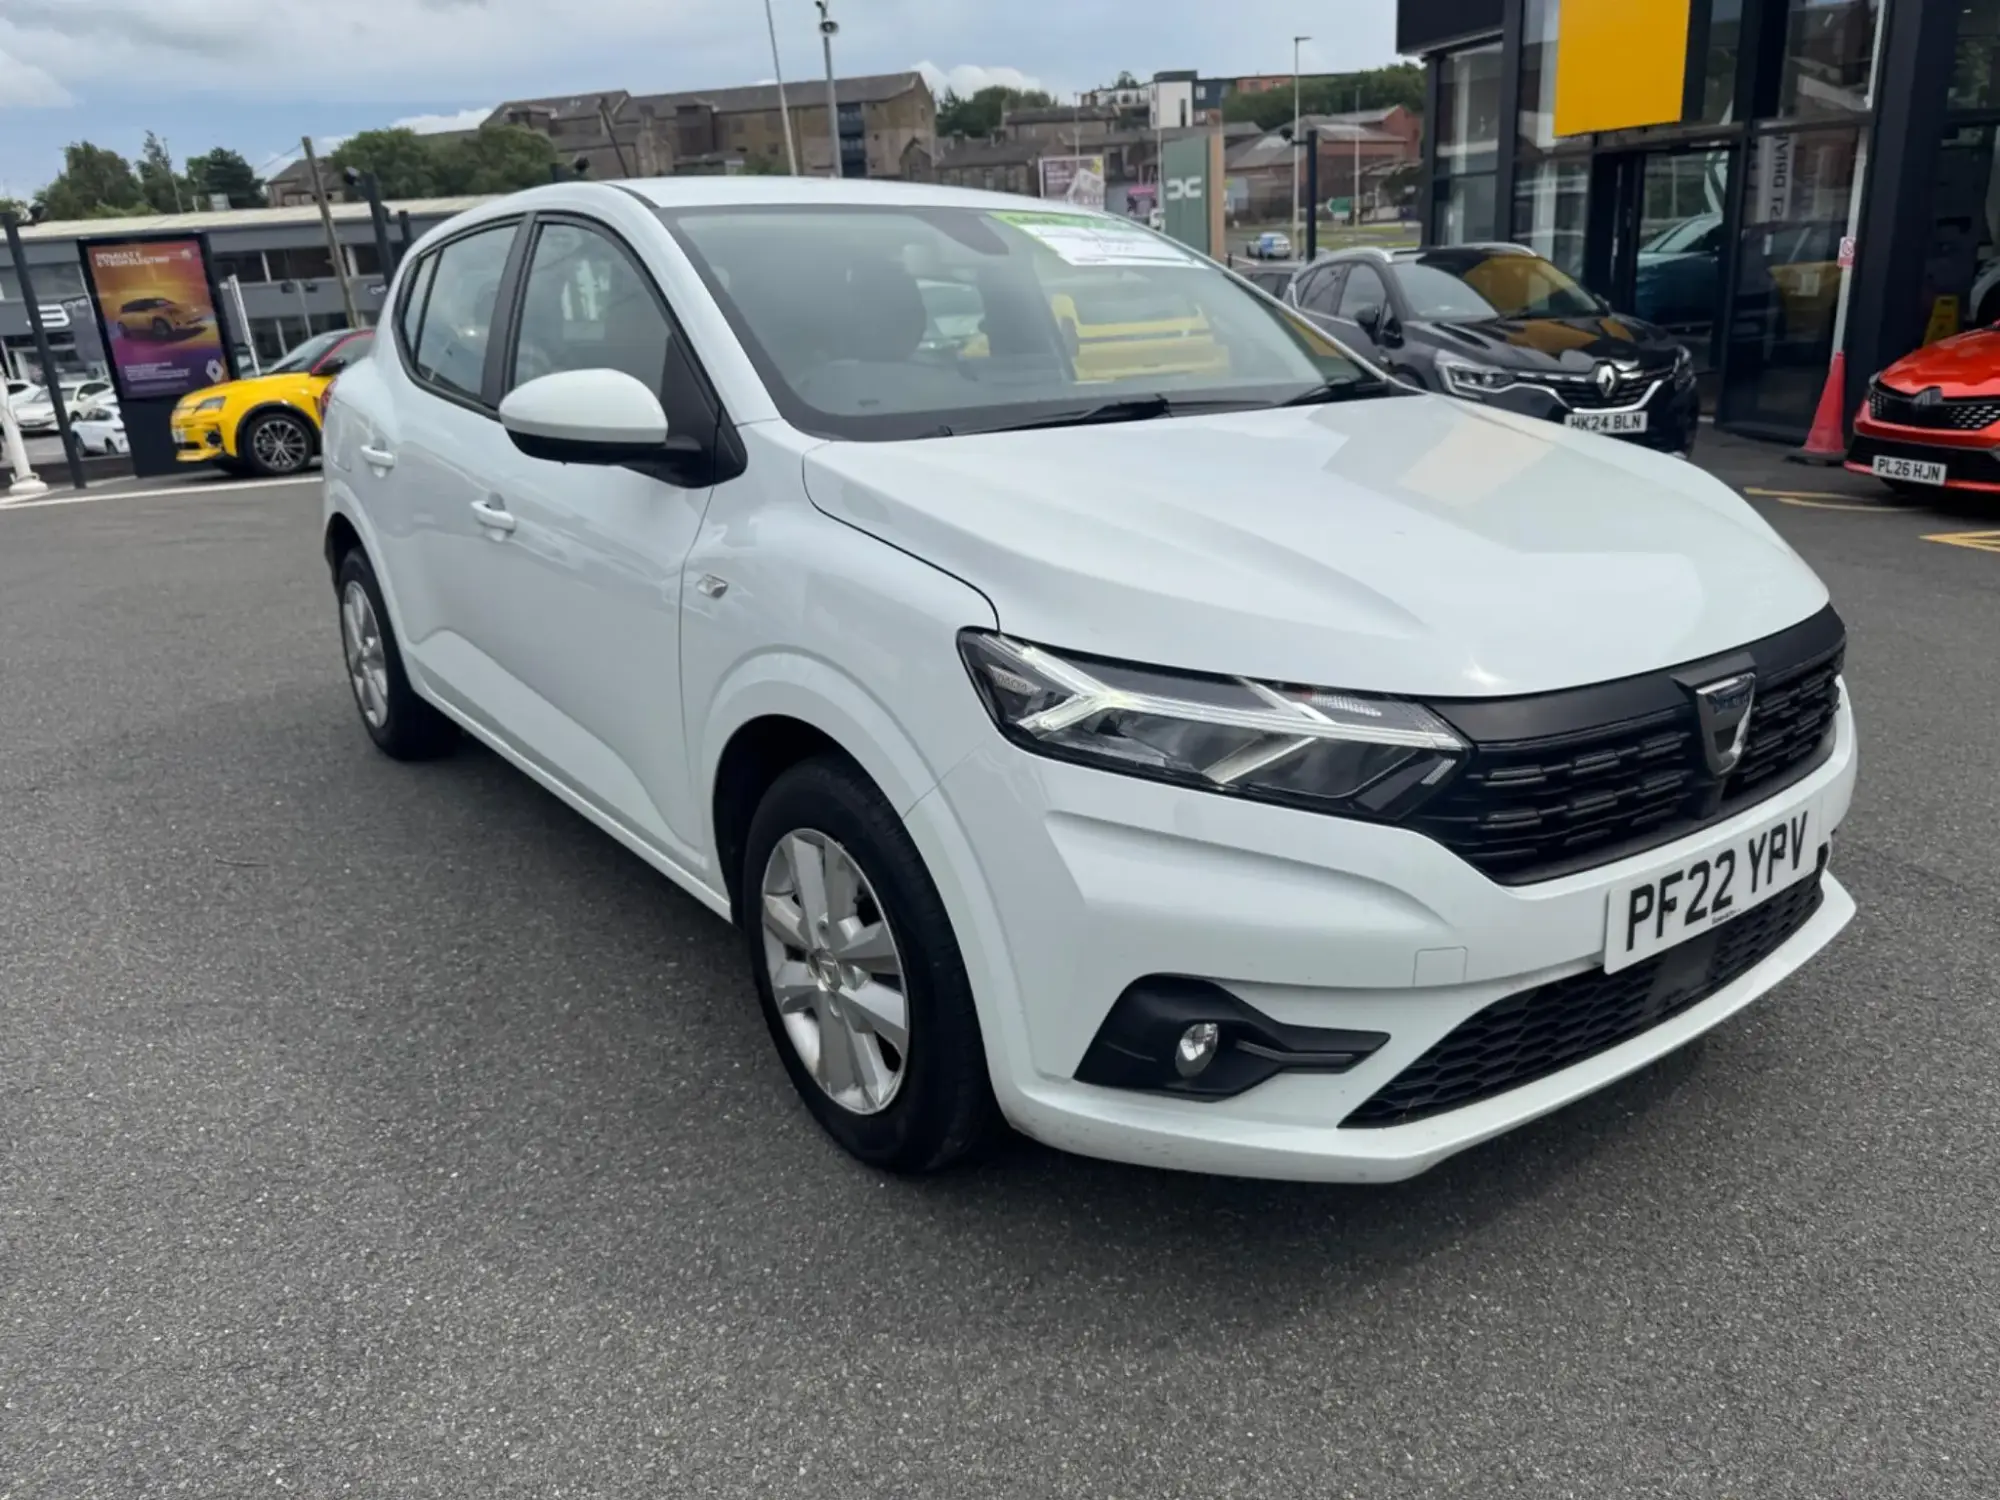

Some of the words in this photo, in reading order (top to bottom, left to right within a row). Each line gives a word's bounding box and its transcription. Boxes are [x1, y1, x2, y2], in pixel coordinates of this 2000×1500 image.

[1571, 415, 1609, 430] HK24
[1614, 414, 1641, 430] BLN
[1877, 458, 1910, 477] PL26
[1913, 463, 1941, 481] HJN
[1626, 848, 1736, 951] PF22
[1749, 810, 1808, 893] YPV
